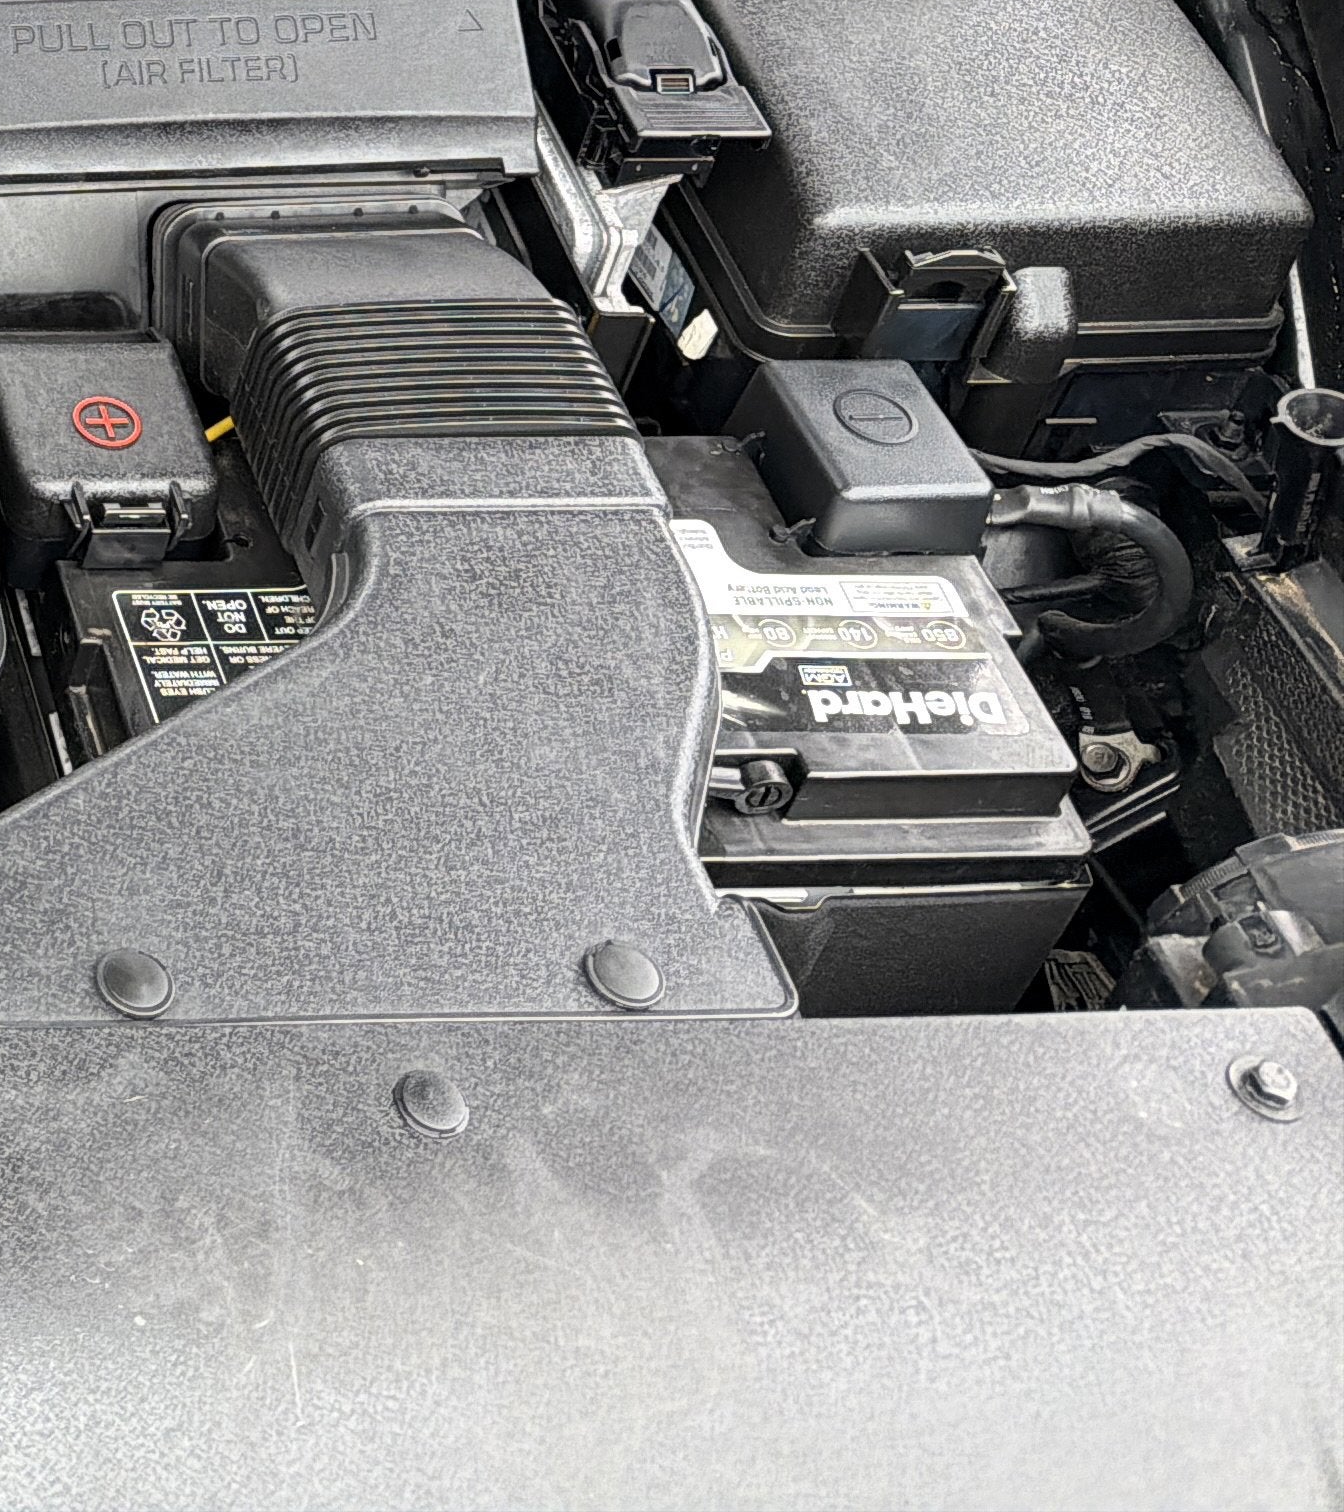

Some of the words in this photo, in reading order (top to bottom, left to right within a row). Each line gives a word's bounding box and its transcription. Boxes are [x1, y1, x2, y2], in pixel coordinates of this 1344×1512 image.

[11, 23, 110, 56] PULL
[121, 18, 197, 49] OUT
[209, 16, 260, 46] TO
[274, 12, 377, 44] OPEN
[202, 599, 247, 610] OPEN.
[734, 596, 834, 607] NON-SPILLABLE
[216, 612, 246, 623] NOT
[224, 623, 248, 634] DO
[274, 626, 296, 635] OUT
[763, 626, 790, 641] 80
[838, 625, 872, 641] 140
